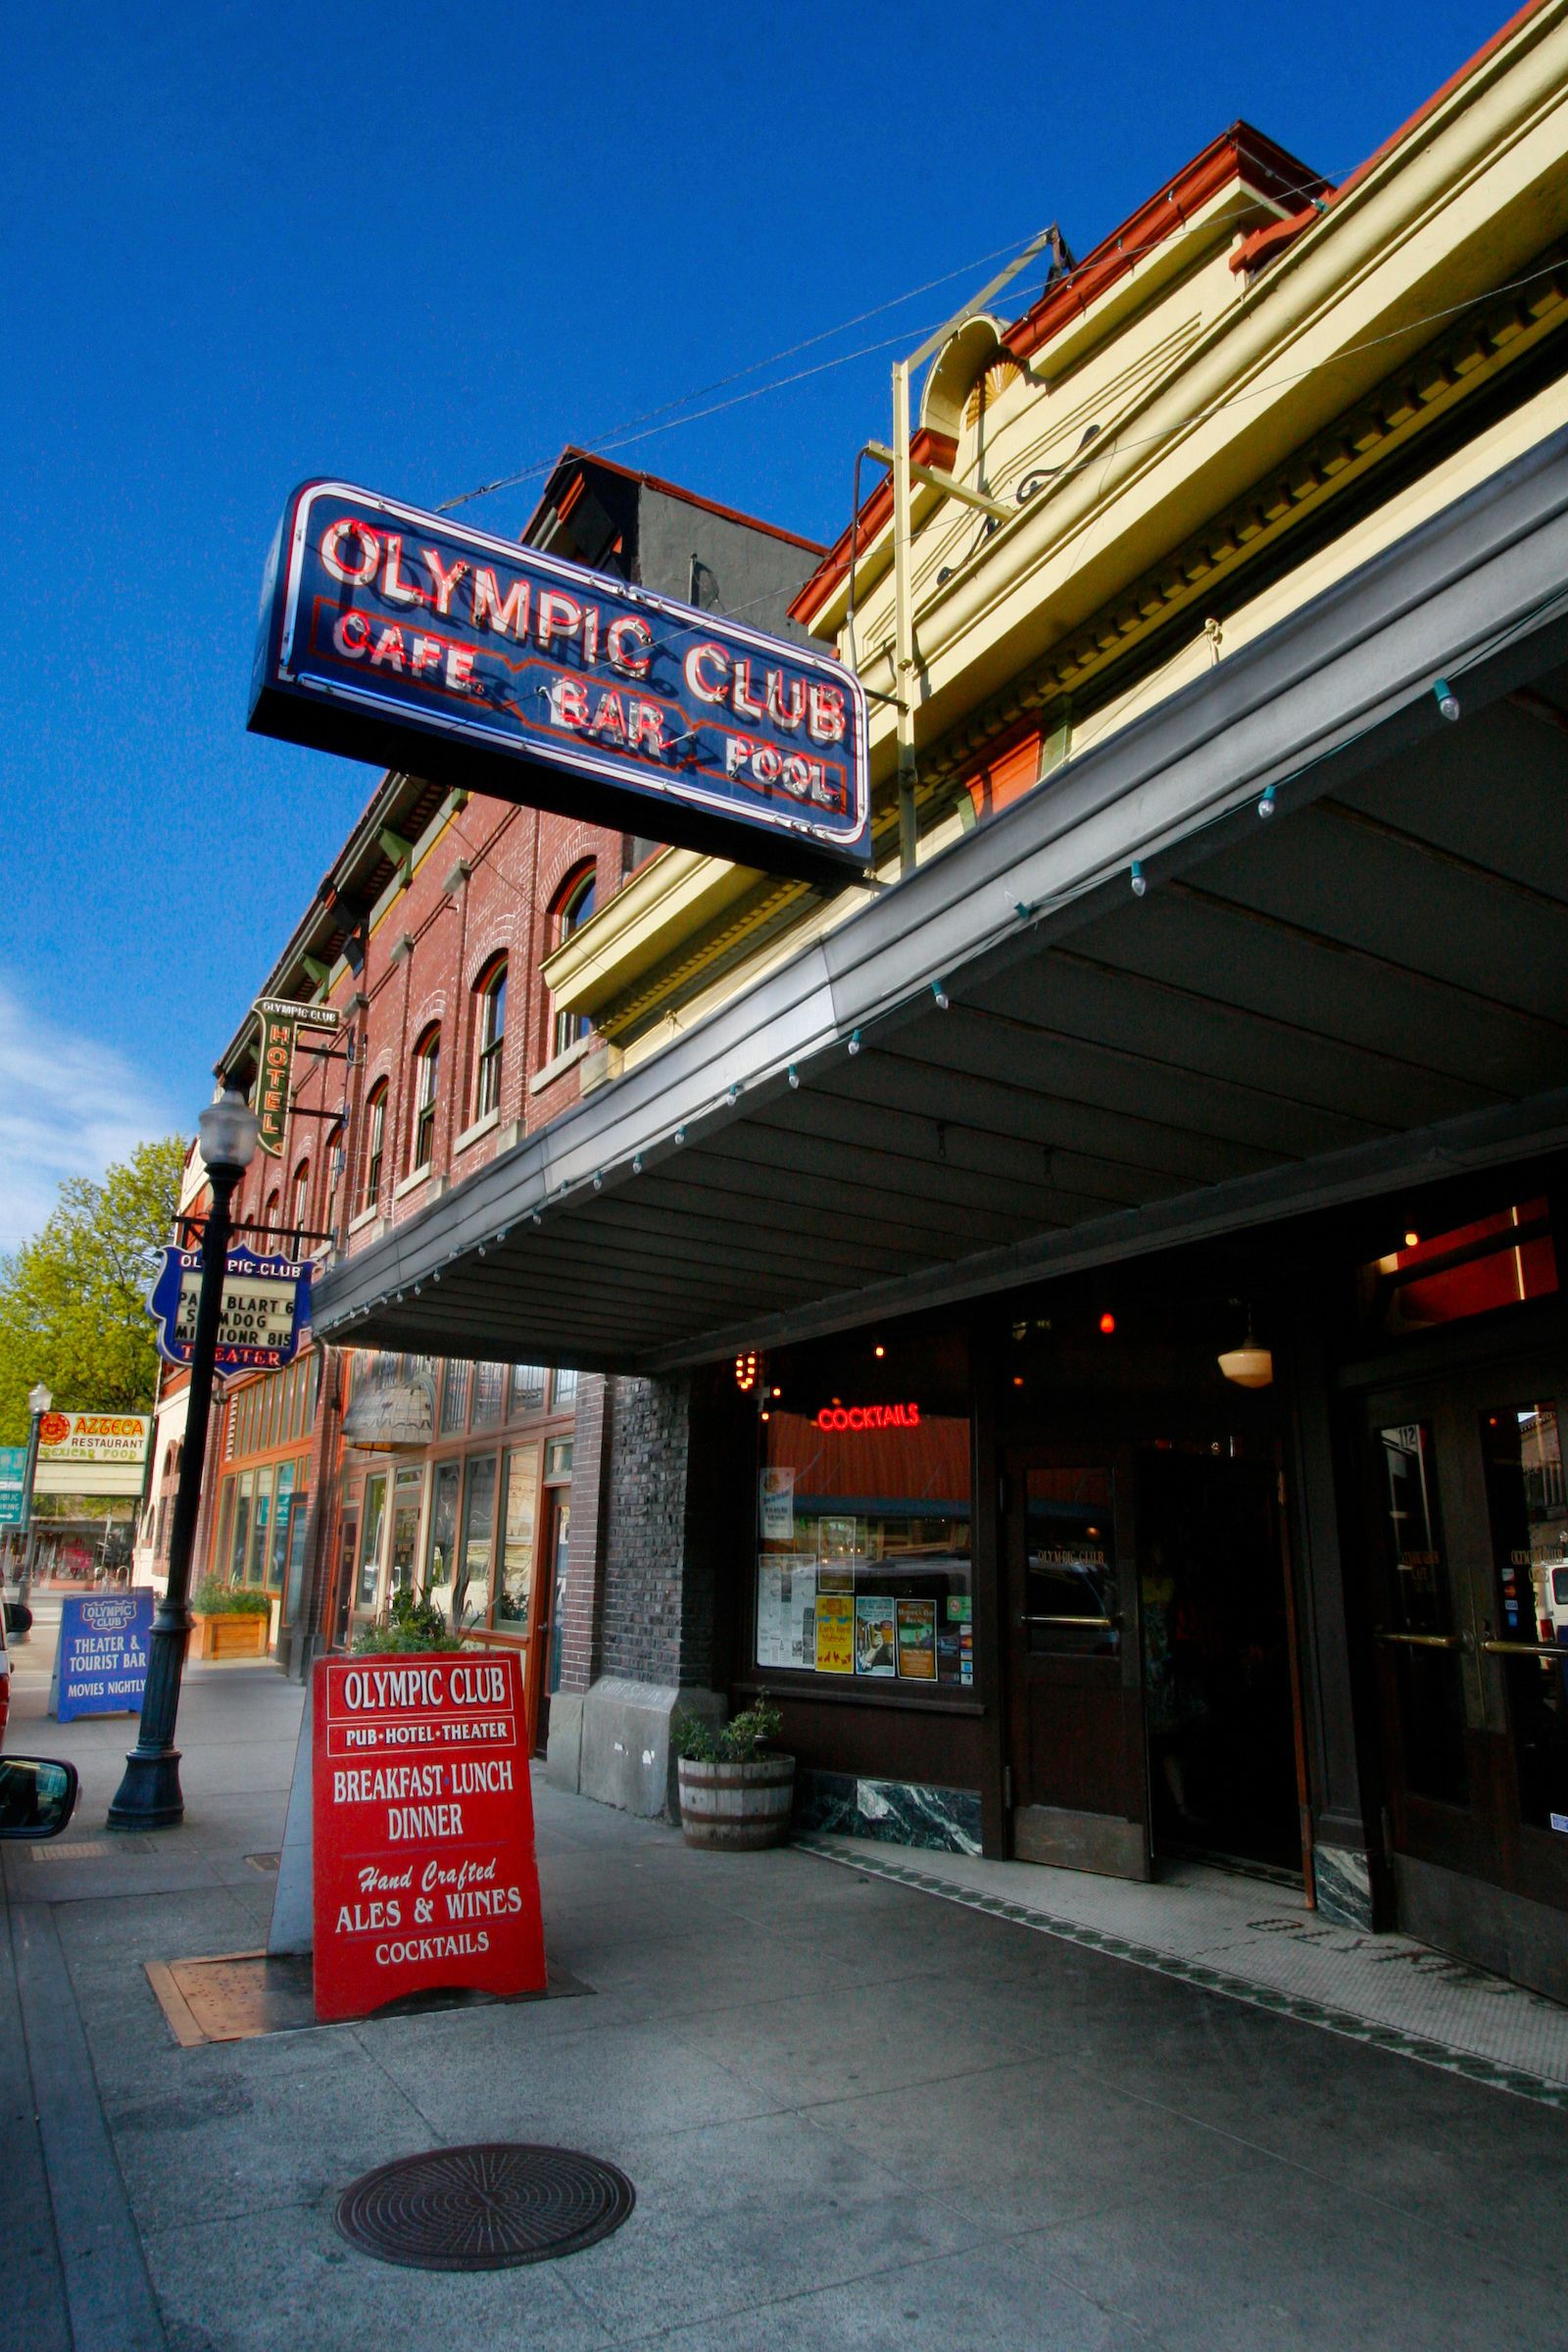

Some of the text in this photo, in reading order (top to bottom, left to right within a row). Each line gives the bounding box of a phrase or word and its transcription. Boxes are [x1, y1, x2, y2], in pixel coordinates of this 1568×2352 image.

[320, 517, 847, 743] OLYMPIC CLUB
[332, 612, 484, 694] CAFE
[549, 676, 666, 757] BAR
[726, 735, 841, 806] POOL
[263, 1002, 336, 1022] OLYMPIC CLUB
[262, 1024, 291, 1134] HOTEL
[180, 1253, 302, 1278] OLPIC CLUB
[226, 1296, 279, 1313] BLART
[186, 1308, 267, 1328] SMDOG
[175, 1325, 259, 1345] MIIONR
[181, 1345, 281, 1366] TEATER
[74, 1416, 144, 1437] AZTECA
[817, 1402, 921, 1431] COCKTAILS
[72, 1438, 144, 1448] RESTAURANT
[103, 1449, 137, 1460] FOOD
[87, 1604, 132, 1619] OLYMPIC
[97, 1617, 122, 1628] CLUB
[74, 1635, 140, 1654] THEATER &
[70, 1652, 146, 1673] TOURIST BAR
[68, 1679, 147, 1698] MOVIES NIGHTLY
[344, 1666, 506, 1710] OLYMPIC CLUB
[333, 1760, 514, 1804] BREAKFAST LUNCH
[388, 1803, 465, 1841] DINNER
[358, 1857, 496, 1893] Hand Crafted
[335, 1886, 523, 1935] ALES & WINES
[375, 1931, 490, 1965] COCKTAILS
